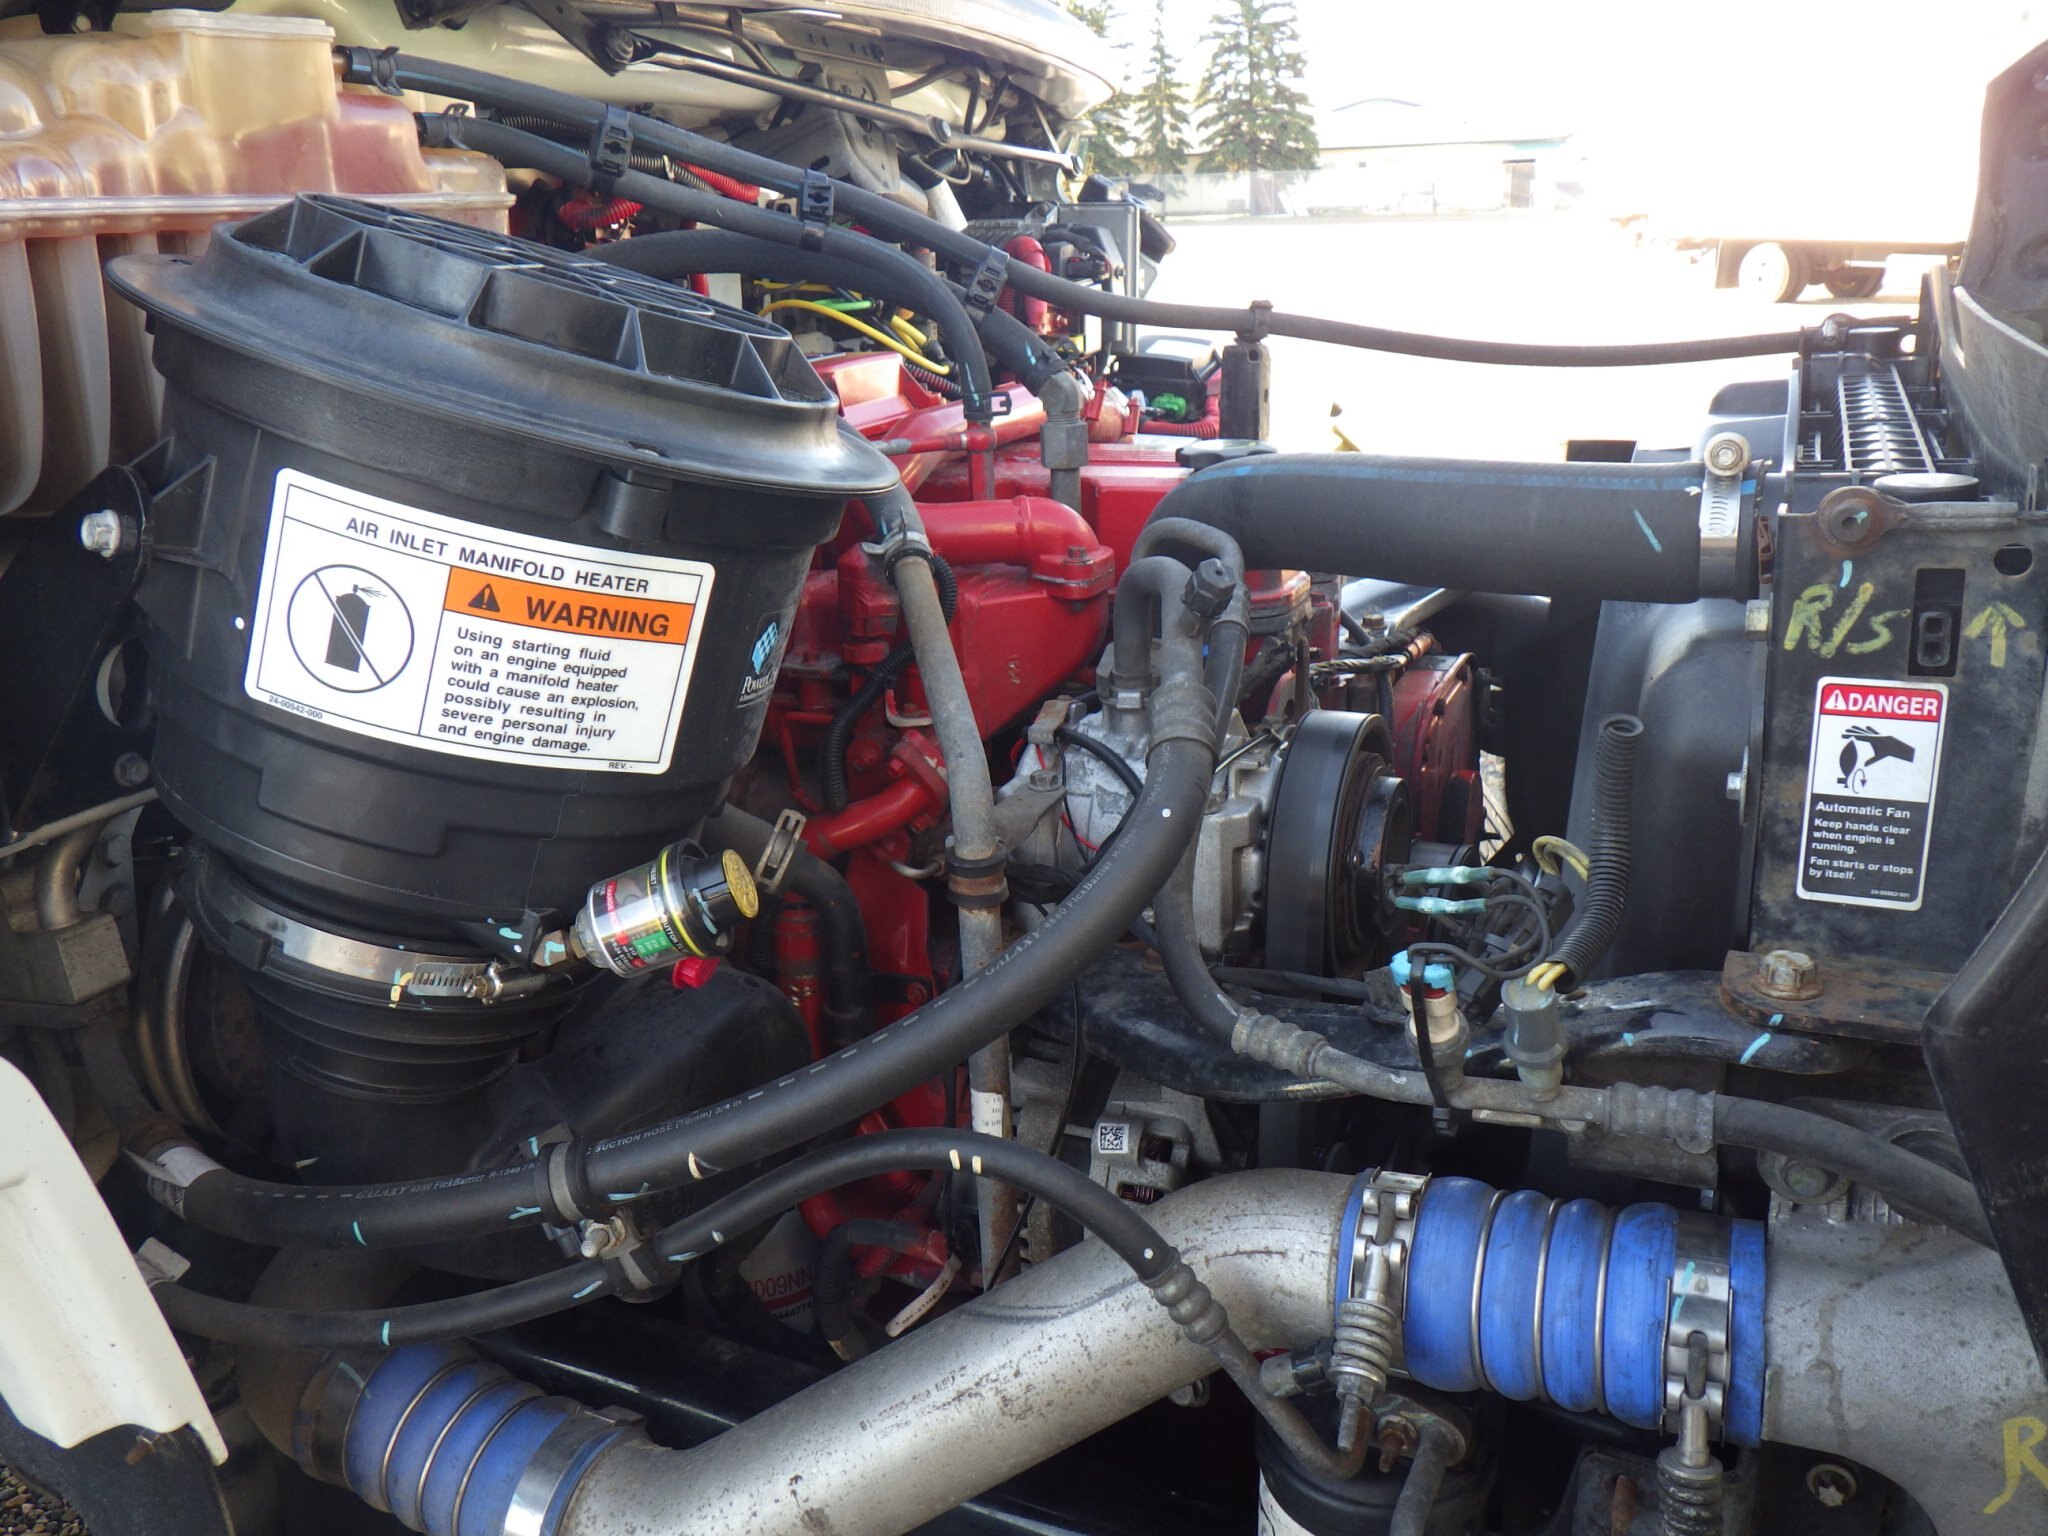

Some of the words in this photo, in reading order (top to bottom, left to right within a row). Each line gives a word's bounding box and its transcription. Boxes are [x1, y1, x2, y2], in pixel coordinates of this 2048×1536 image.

[346, 517, 378, 539] AIR
[389, 528, 448, 558] INLET
[459, 547, 565, 582] MANIFOLD
[575, 569, 650, 594] HEATER
[525, 596, 671, 637] WARNING
[457, 627, 503, 649] Using
[512, 639, 570, 662] starting
[579, 647, 611, 662] fluid
[451, 660, 483, 676] with
[489, 668, 499, 678] a
[506, 671, 569, 690] manifold
[575, 679, 619, 693] heater
[453, 646, 474, 660] on
[481, 650, 500, 662] an
[507, 653, 557, 675] engine
[563, 662, 627, 680] equipped
[268, 695, 323, 720] 24-00542-000
[444, 692, 510, 715] possibly
[519, 703, 587, 724] resulting
[593, 710, 606, 722] in
[447, 675, 489, 692] could
[496, 685, 540, 699] cause
[547, 692, 565, 703] an
[571, 693, 639, 711] explosion,
[1848, 693, 1938, 717] DANGER
[438, 721, 468, 737] and
[474, 727, 525, 747] engine
[532, 735, 590, 754] damage.
[441, 708, 493, 725] severe
[502, 717, 568, 735] personal
[575, 723, 616, 740] injury
[1816, 801, 1883, 817] Automatic
[1887, 807, 1910, 819] Fan
[1813, 830, 1842, 841] when
[1845, 833, 1883, 845] engine
[1885, 836, 1895, 845] is
[1814, 818, 1842, 830] Keep
[1845, 821, 1879, 833] hands
[1882, 825, 1910, 835] clear
[1812, 842, 1856, 854] running.
[1809, 868, 1823, 880] by
[1825, 868, 1855, 880] itself.
[1810, 856, 1830, 867] Fan
[1832, 859, 1865, 870] starts
[1868, 862, 1880, 871] or
[1882, 863, 1914, 875] stops
[596, 1134, 641, 1153] SUCTION
[643, 1123, 673, 1139] HOSE
[715, 1103, 730, 1114] 3/4
